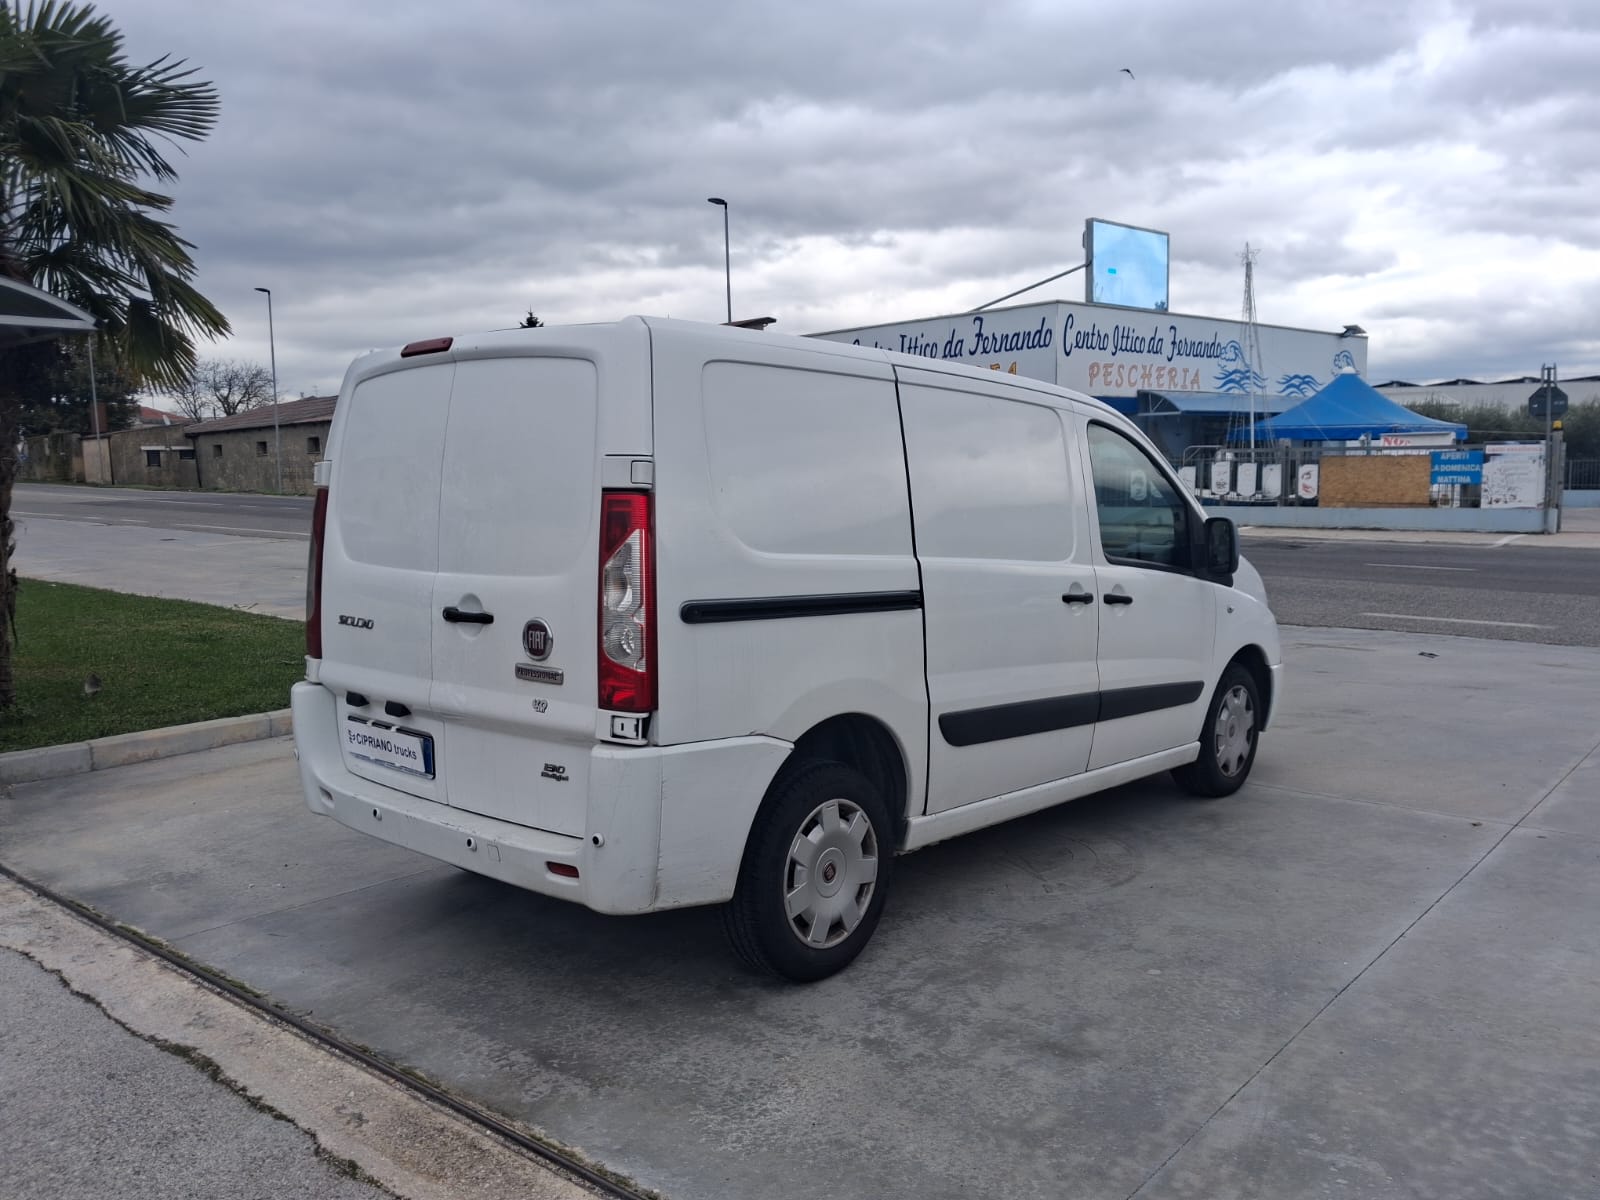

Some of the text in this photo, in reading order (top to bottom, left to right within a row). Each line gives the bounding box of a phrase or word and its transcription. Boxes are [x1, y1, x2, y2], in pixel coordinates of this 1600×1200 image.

[941, 328, 964, 358] da
[968, 316, 1053, 356] Fernando
[1063, 313, 1222, 362] Centro Ittico da Fernando
[1088, 362, 1201, 390] PESCHERIA
[1440, 452, 1470, 460] APERTI
[1440, 463, 1481, 472] DOMENICA
[1437, 475, 1472, 484] MATTINA
[338, 614, 375, 630] SCUDO
[528, 630, 545, 649] FIAT
[356, 732, 417, 760] CIPRIANO trucks
